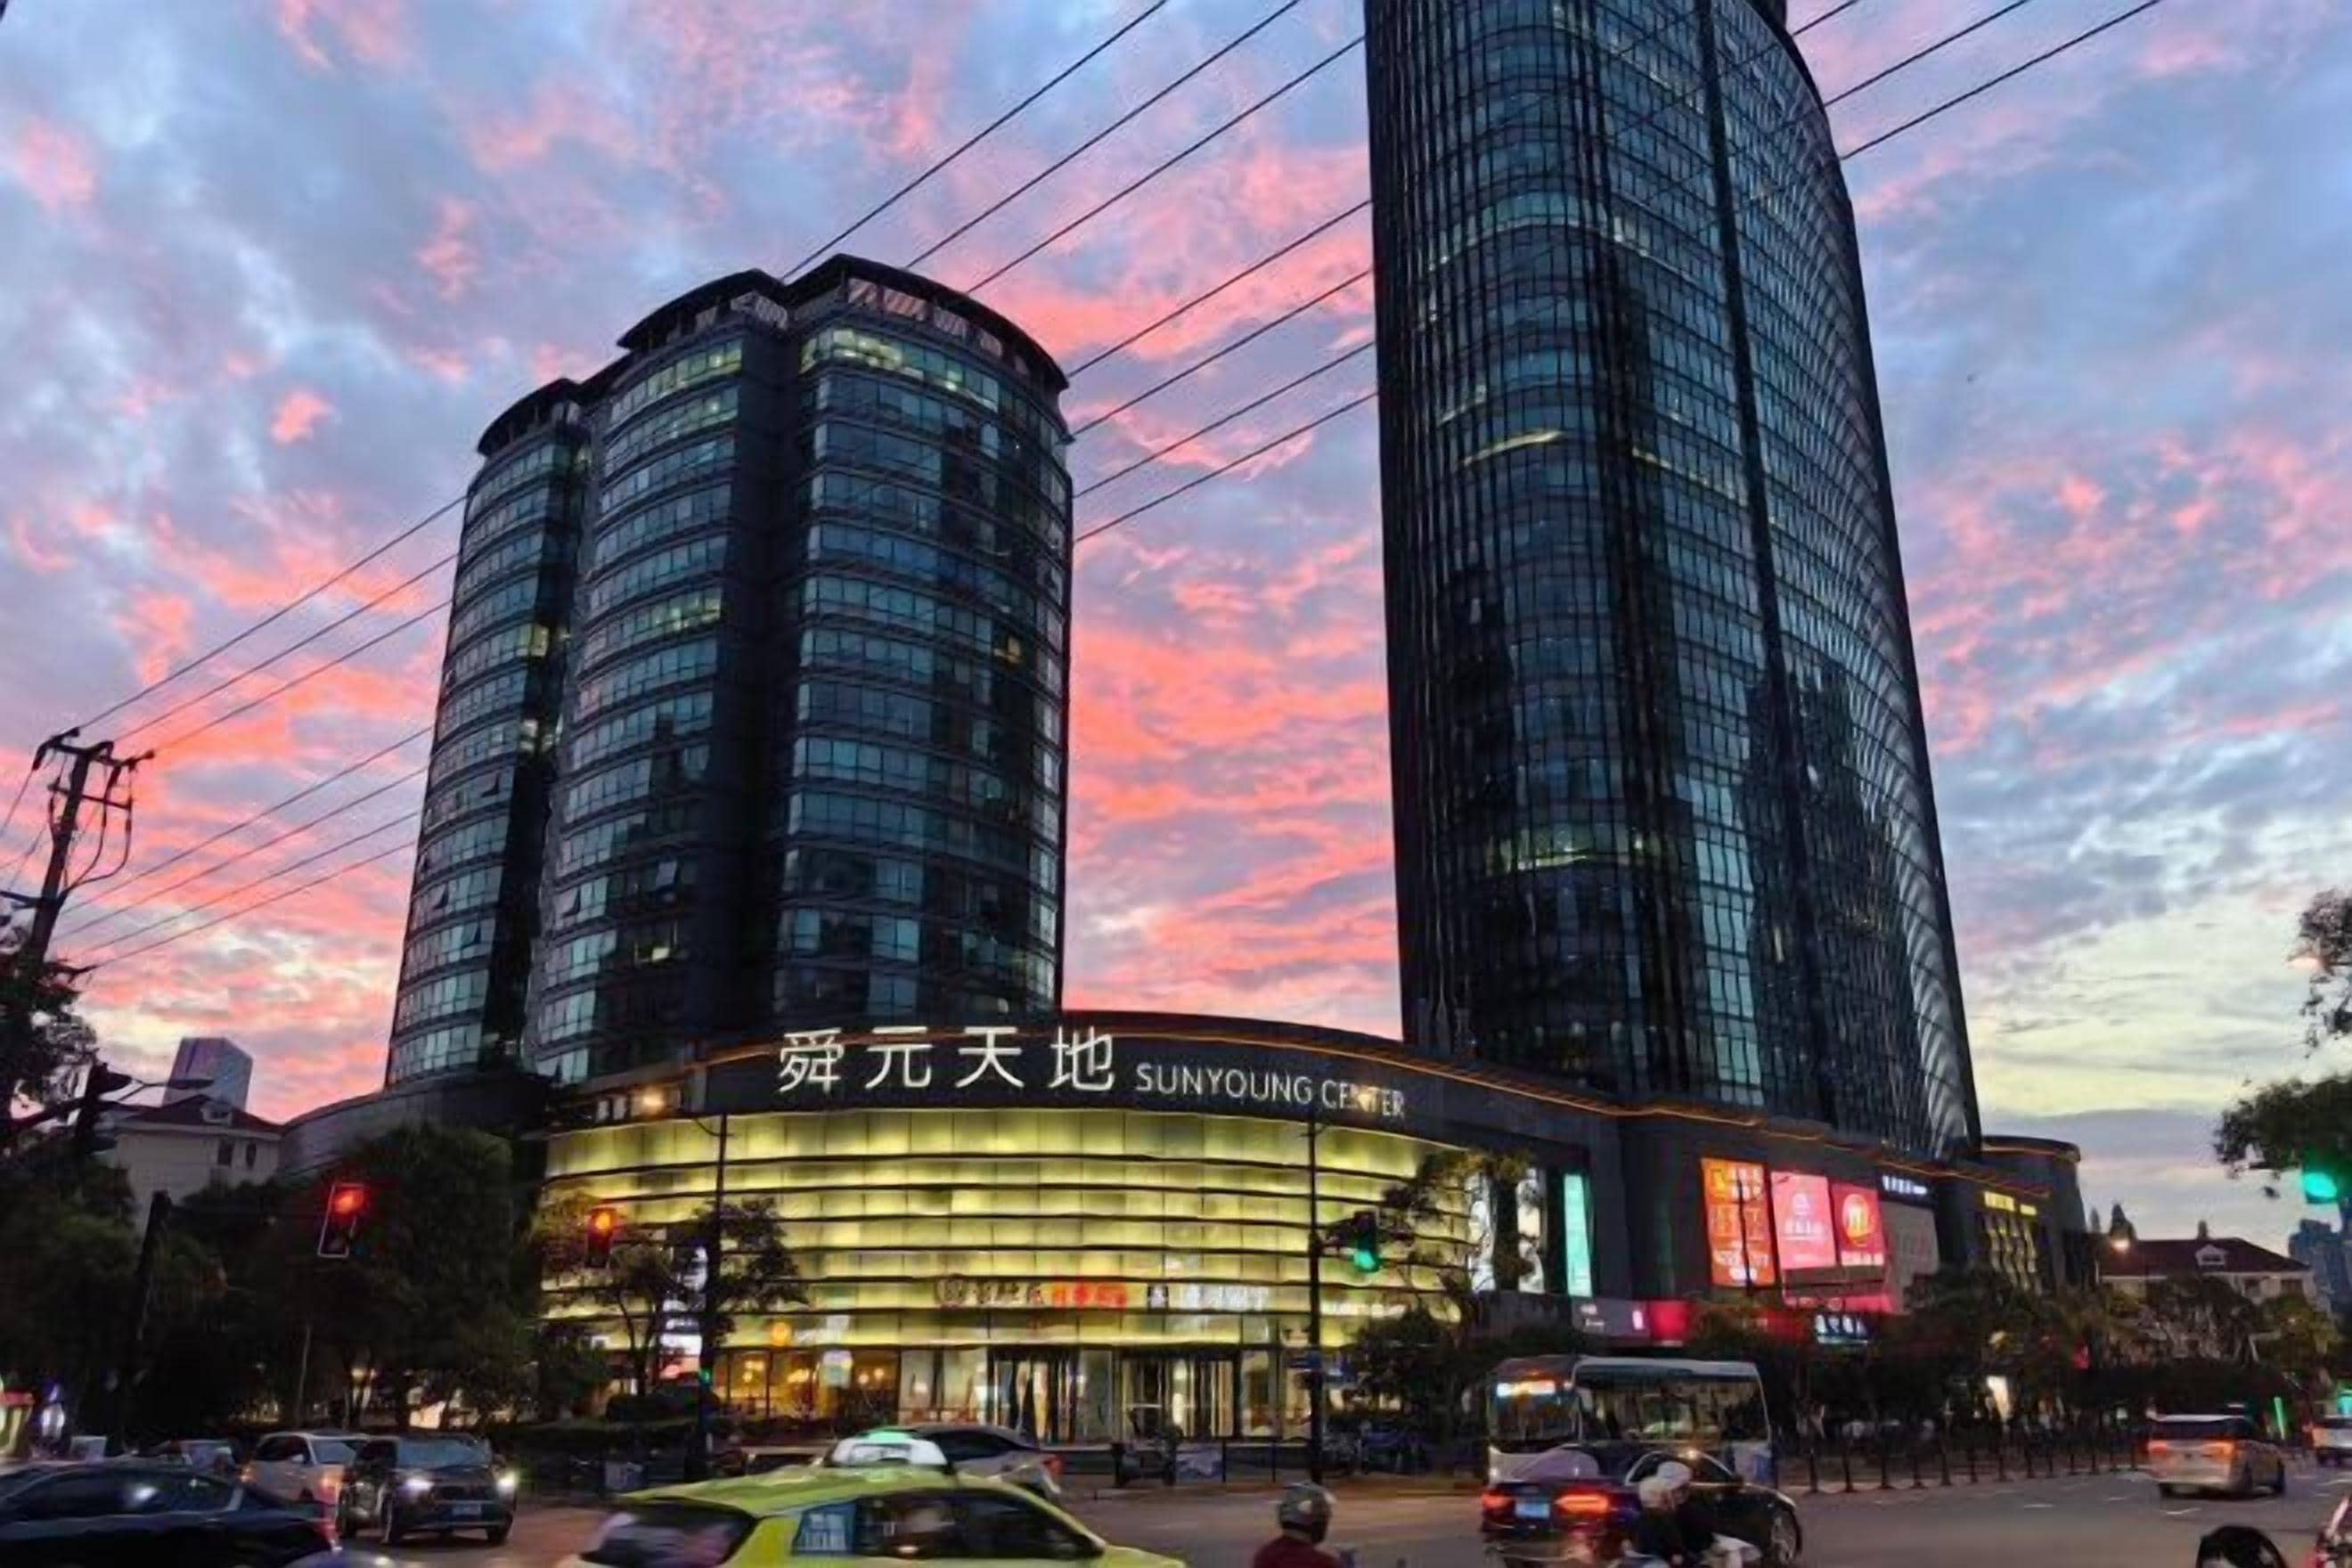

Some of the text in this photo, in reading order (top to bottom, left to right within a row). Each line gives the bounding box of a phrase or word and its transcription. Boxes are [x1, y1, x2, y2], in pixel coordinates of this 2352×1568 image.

[779, 1025, 1115, 1093] 舜元天地
[1136, 1063, 1312, 1105] SUNYOUNG
